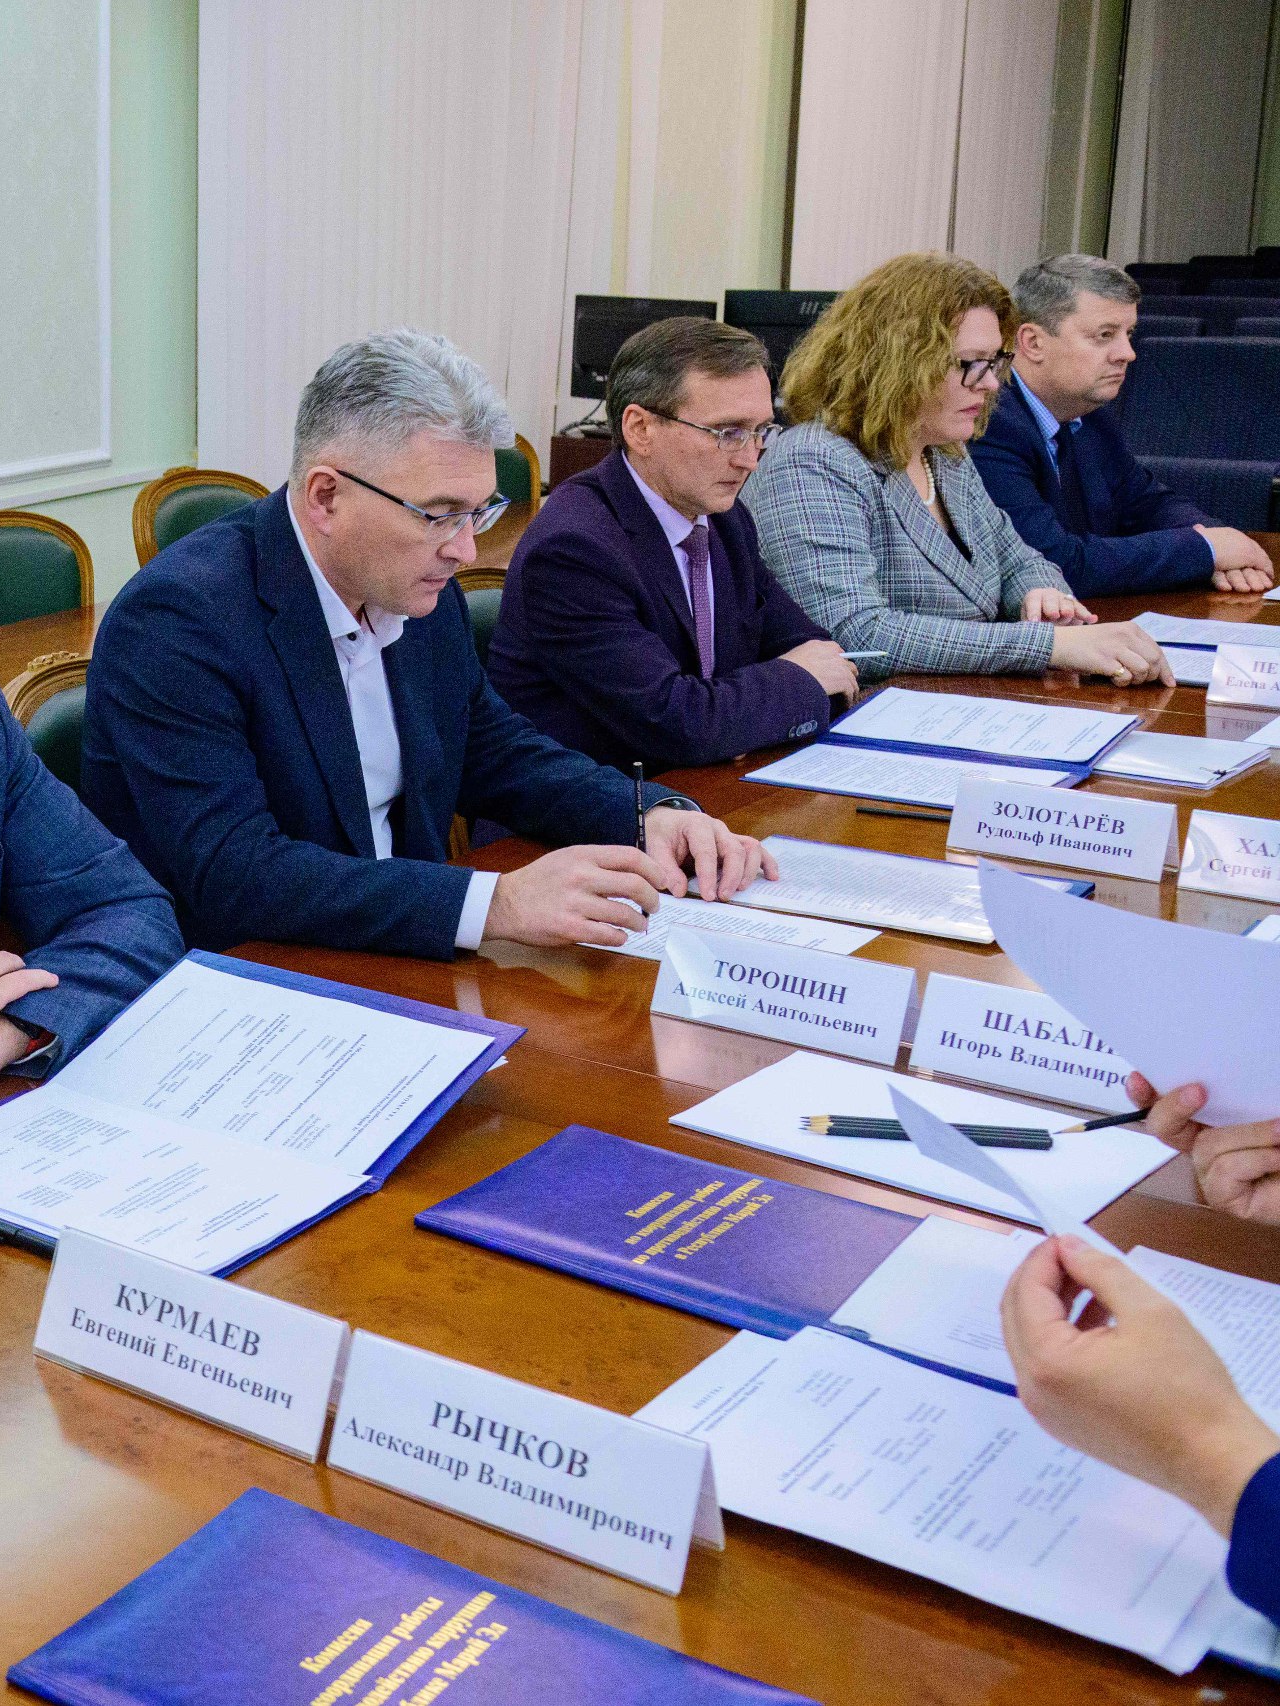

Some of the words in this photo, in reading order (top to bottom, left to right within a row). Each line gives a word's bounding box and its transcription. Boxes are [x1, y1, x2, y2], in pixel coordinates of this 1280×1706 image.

[1224, 676, 1266, 690] Елена
[1270, 681, 1280, 692] А
[1252, 660, 1279, 675] ПЕ
[976, 821, 1045, 847] Рудольф
[1049, 833, 1133, 858] Иванович
[991, 801, 1126, 836] ЗОЛОТАРЁВ
[1208, 858, 1272, 880] Сергей
[714, 959, 848, 1004] ТОРОЩИН
[672, 980, 747, 1009] Алексей
[751, 998, 878, 1038] Анатольевич
[940, 1030, 1002, 1059] Игорь
[690, 1181, 724, 1203] работы
[724, 1201, 763, 1223] Марий
[751, 1194, 773, 1204] Эл
[115, 1284, 261, 1357] КУРМАЕВ
[70, 1307, 157, 1359] Евгений
[162, 1342, 293, 1410] Евгеньевич
[430, 1401, 590, 1479] РЫЧКОВ
[342, 1414, 470, 1482] Александр
[477, 1462, 675, 1552] Владимирович
[390, 1596, 444, 1641] работы
[425, 1591, 496, 1650] коррупции
[433, 1637, 491, 1680] Марий
[474, 1621, 508, 1641] Эл
